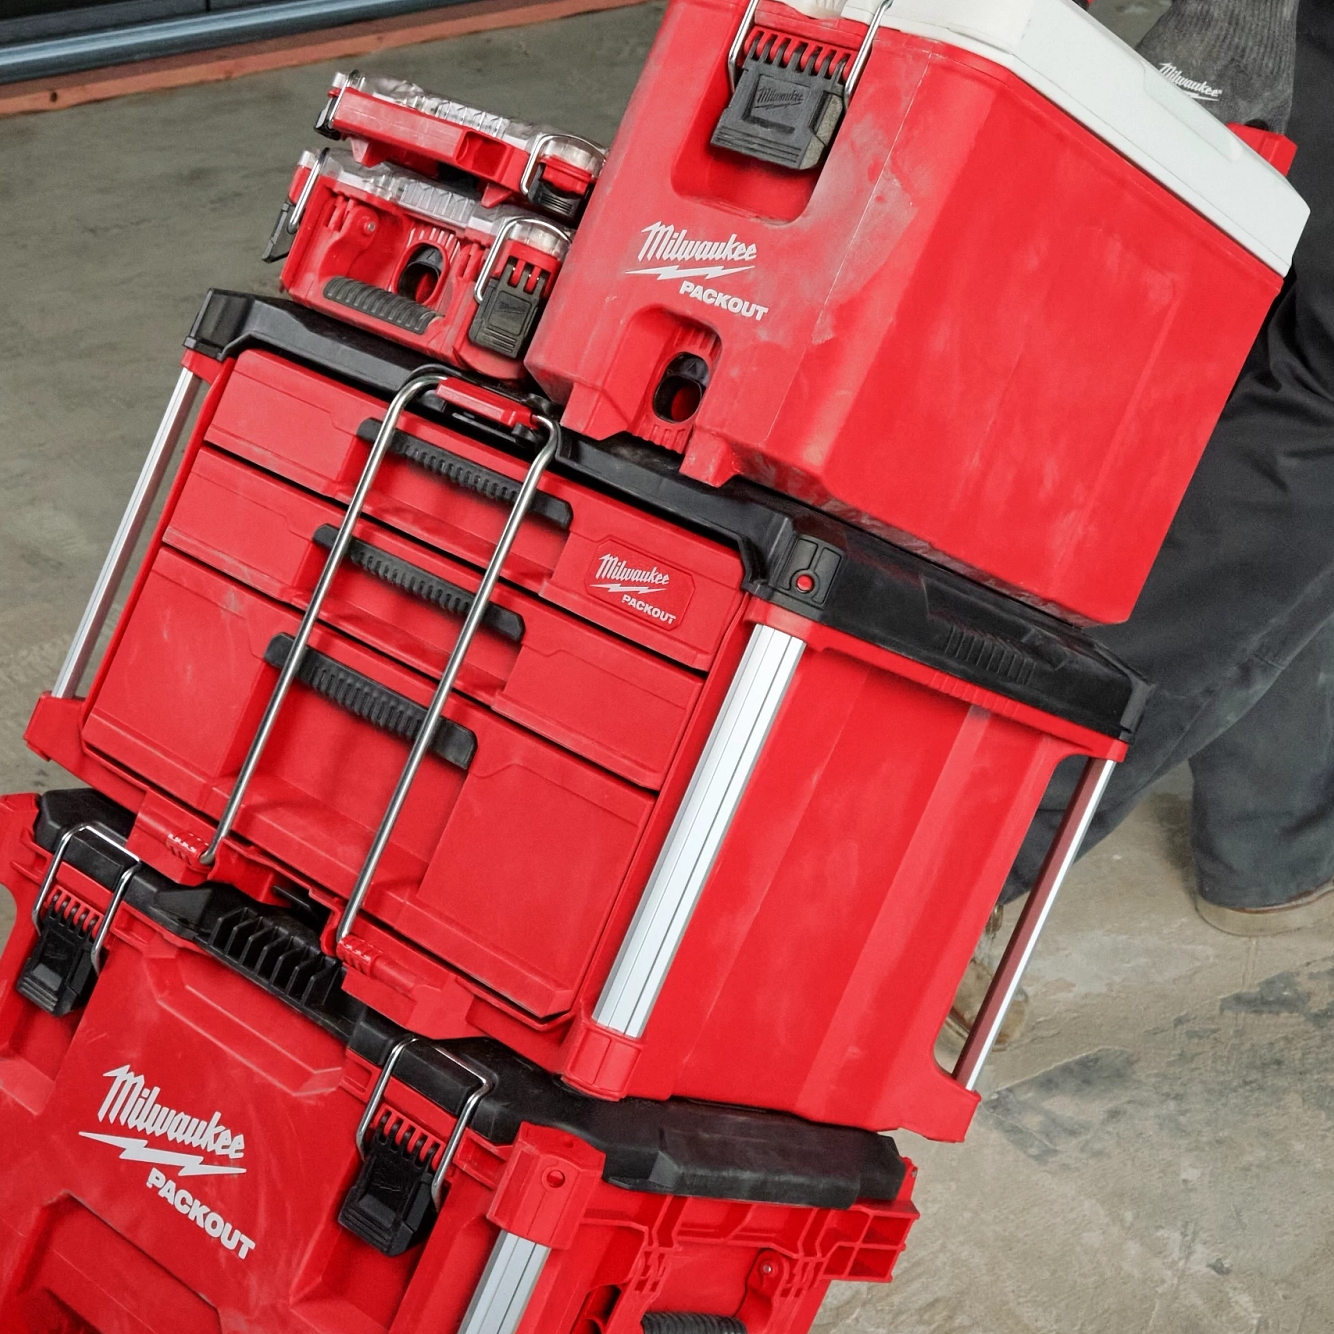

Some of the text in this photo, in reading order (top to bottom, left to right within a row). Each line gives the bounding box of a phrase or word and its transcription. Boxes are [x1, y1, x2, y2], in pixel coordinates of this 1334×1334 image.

[637, 221, 757, 262] Milwaukee
[679, 280, 769, 321] PACKOUT
[595, 553, 670, 585] Milwaukee
[621, 594, 676, 624] PACKOUT
[97, 1064, 245, 1159] Milwaukee
[146, 1167, 256, 1260] PACKOUT
